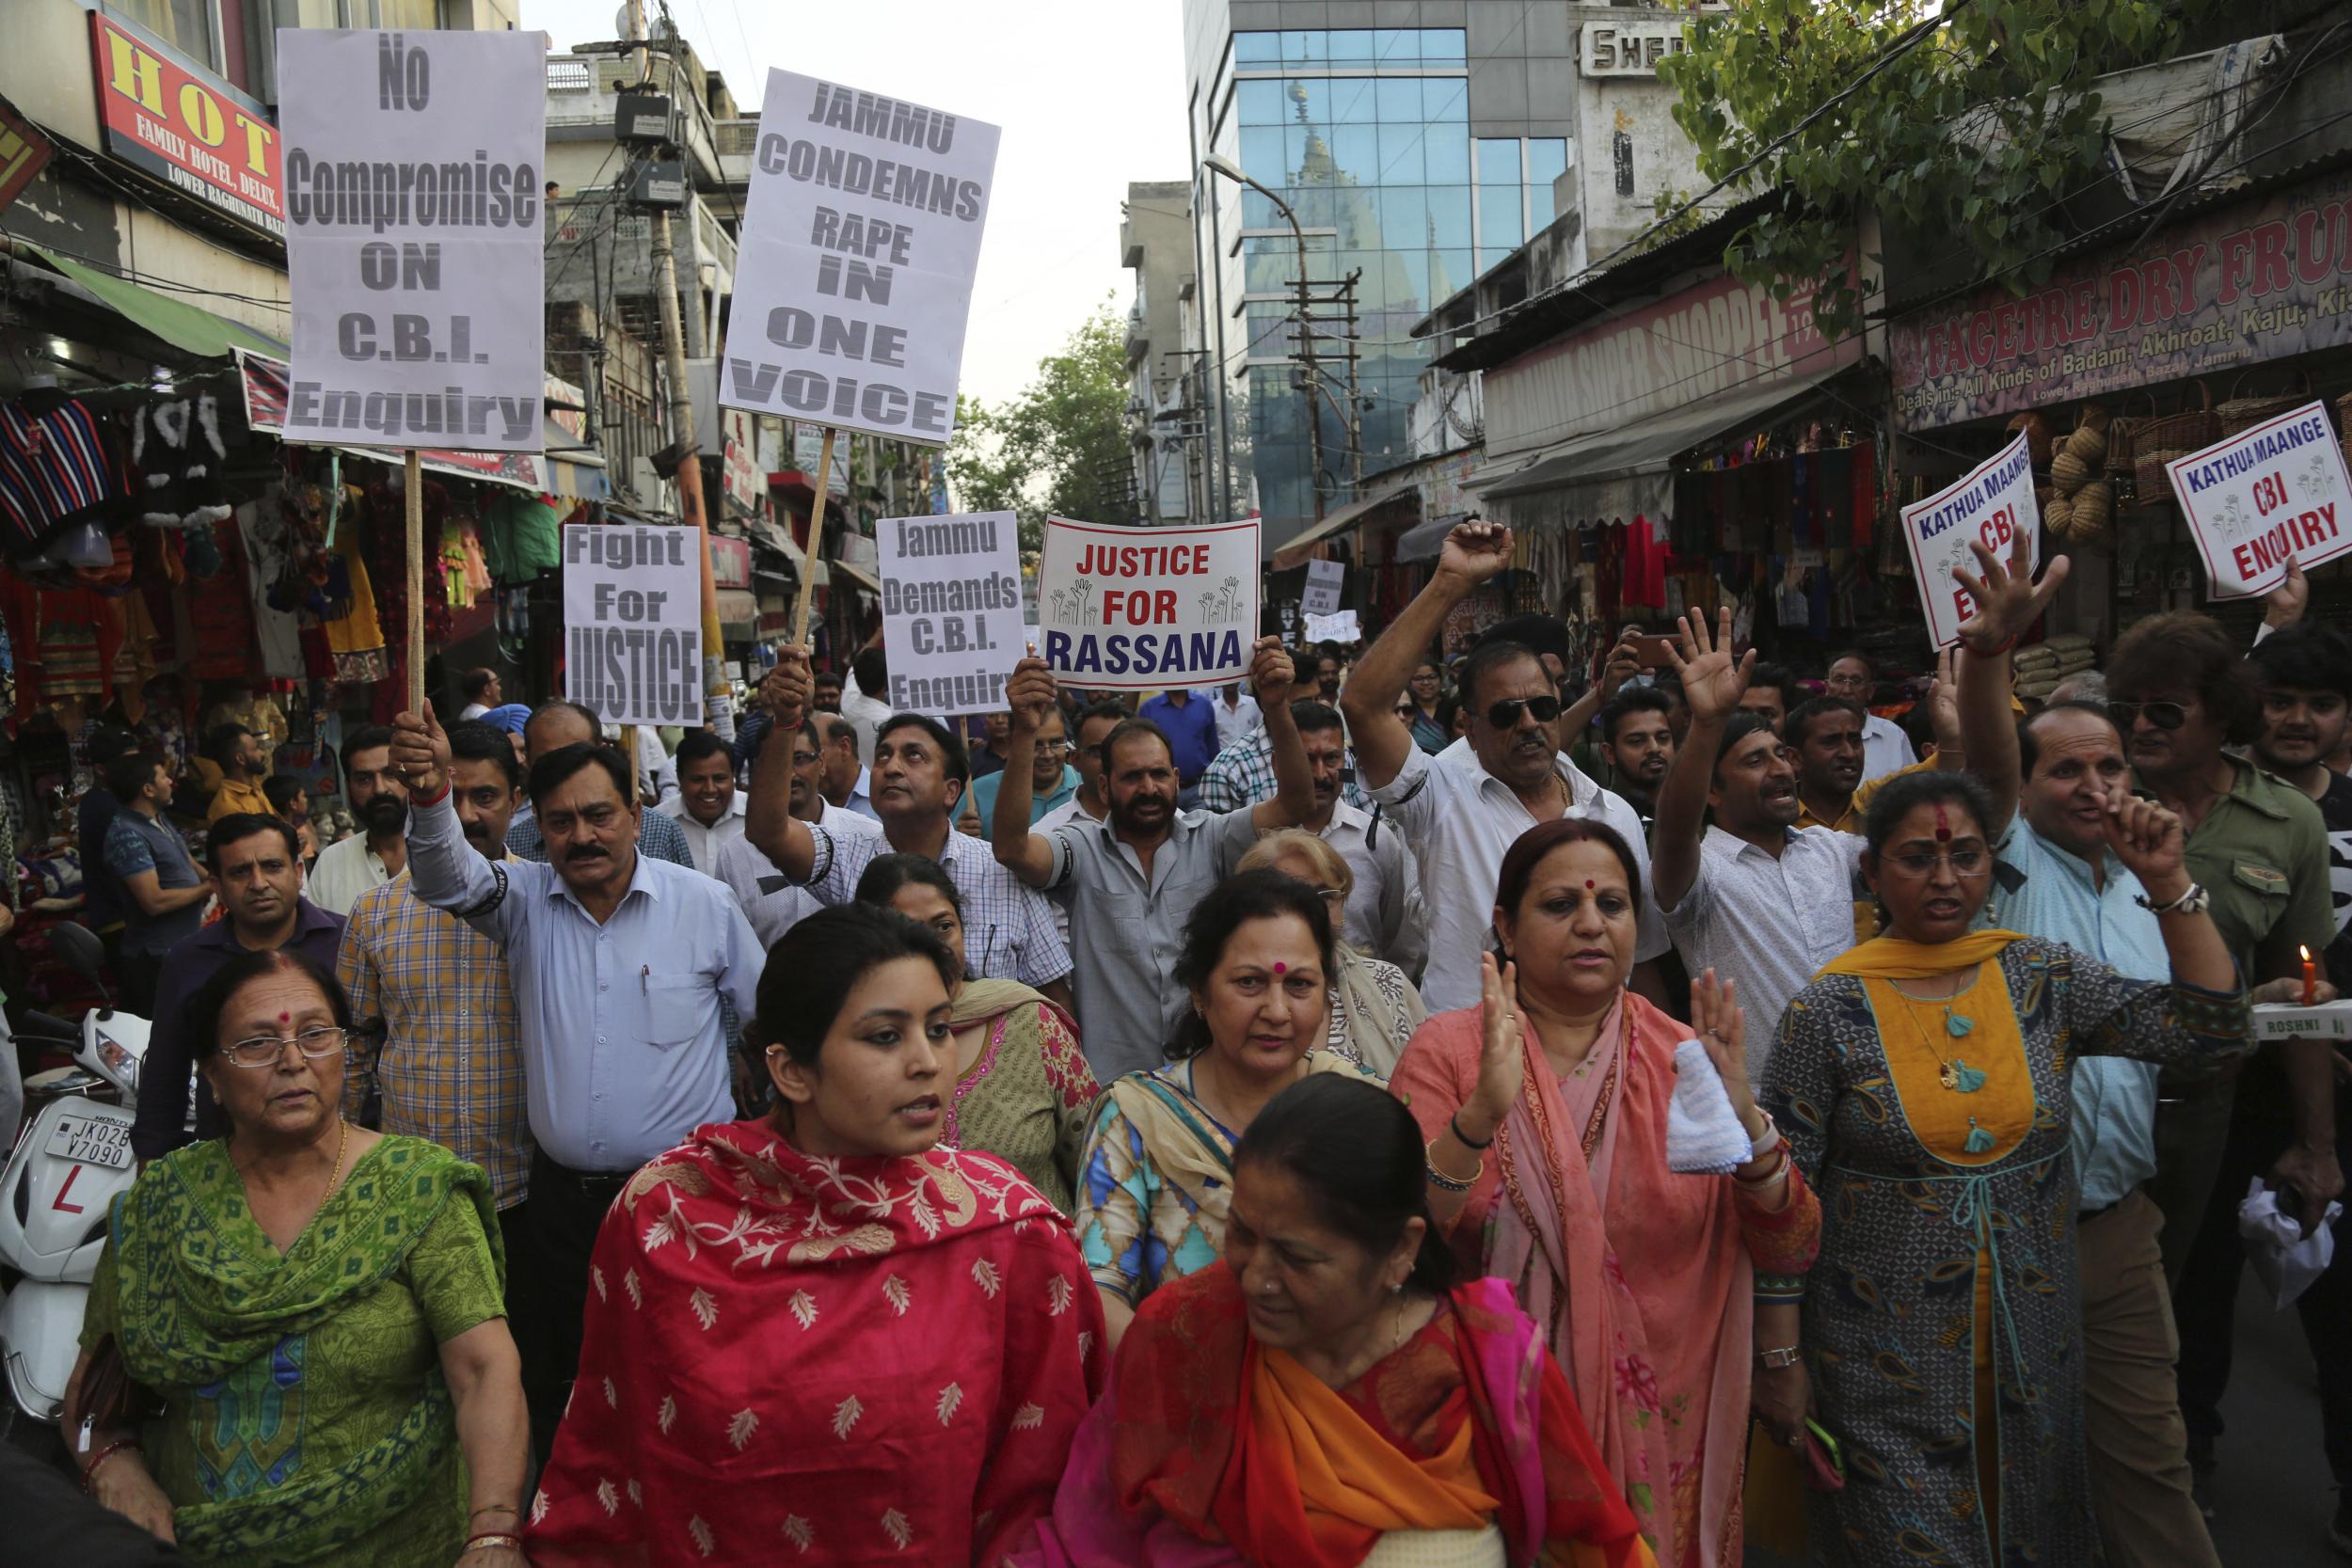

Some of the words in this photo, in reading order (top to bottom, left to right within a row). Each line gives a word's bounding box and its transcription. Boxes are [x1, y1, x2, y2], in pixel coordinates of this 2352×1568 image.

[808, 82, 956, 154] JAMMU
[135, 113, 186, 162] FAMILY
[190, 145, 238, 191] HOTEL,
[239, 173, 280, 214] DELUX,
[287, 148, 535, 232] Compromise
[758, 133, 982, 222] CONDEMNS
[167, 163, 206, 198] LOWER
[208, 186, 264, 230] RAGHUNATH
[810, 205, 914, 265] RAPE
[360, 242, 441, 291] ON
[817, 254, 893, 306] IN
[338, 312, 488, 363] C.B.I.
[767, 307, 907, 367] ONE
[1928, 278, 2098, 378] FAGETRE
[2106, 244, 2206, 333] DRY
[1577, 326, 1657, 423] SUPER
[1652, 273, 1792, 410] SHOPPEE
[1898, 388, 1934, 412] Deals
[1963, 376, 1984, 398] All
[1990, 367, 2033, 392] Kinds
[2039, 356, 2057, 378] of
[2062, 345, 2133, 376] Badam,
[2139, 316, 2234, 358] Akhroat,
[2242, 302, 2307, 336] Kaju,
[2033, 384, 2069, 402] Lower
[2195, 347, 2251, 370] Jammu
[289, 382, 535, 440] Enquiry
[729, 358, 948, 433] VOICE
[2186, 446, 2257, 493] KATHUA
[2252, 417, 2326, 464] MAANGE
[1919, 486, 1986, 541] KATHUA
[1983, 444, 2029, 499] MAANGE
[2253, 471, 2289, 516] CBI
[566, 526, 685, 570] Fight
[1979, 502, 2016, 554] CBI
[2233, 502, 2339, 581] ENQUIRY
[1076, 544, 1210, 578] JUSTICE
[595, 583, 667, 622] For
[882, 571, 1018, 615] Demands
[1103, 590, 1178, 626] FOR
[911, 614, 996, 656] C.B.I.
[1045, 629, 1242, 674] RASSANA
[571, 626, 699, 721] JUSTICE
[890, 669, 1012, 710] Enquir
[2266, 1019, 2320, 1033] ROSHNI
[73, 1121, 131, 1147] JK02B
[94, 1116, 134, 1128] HOND
